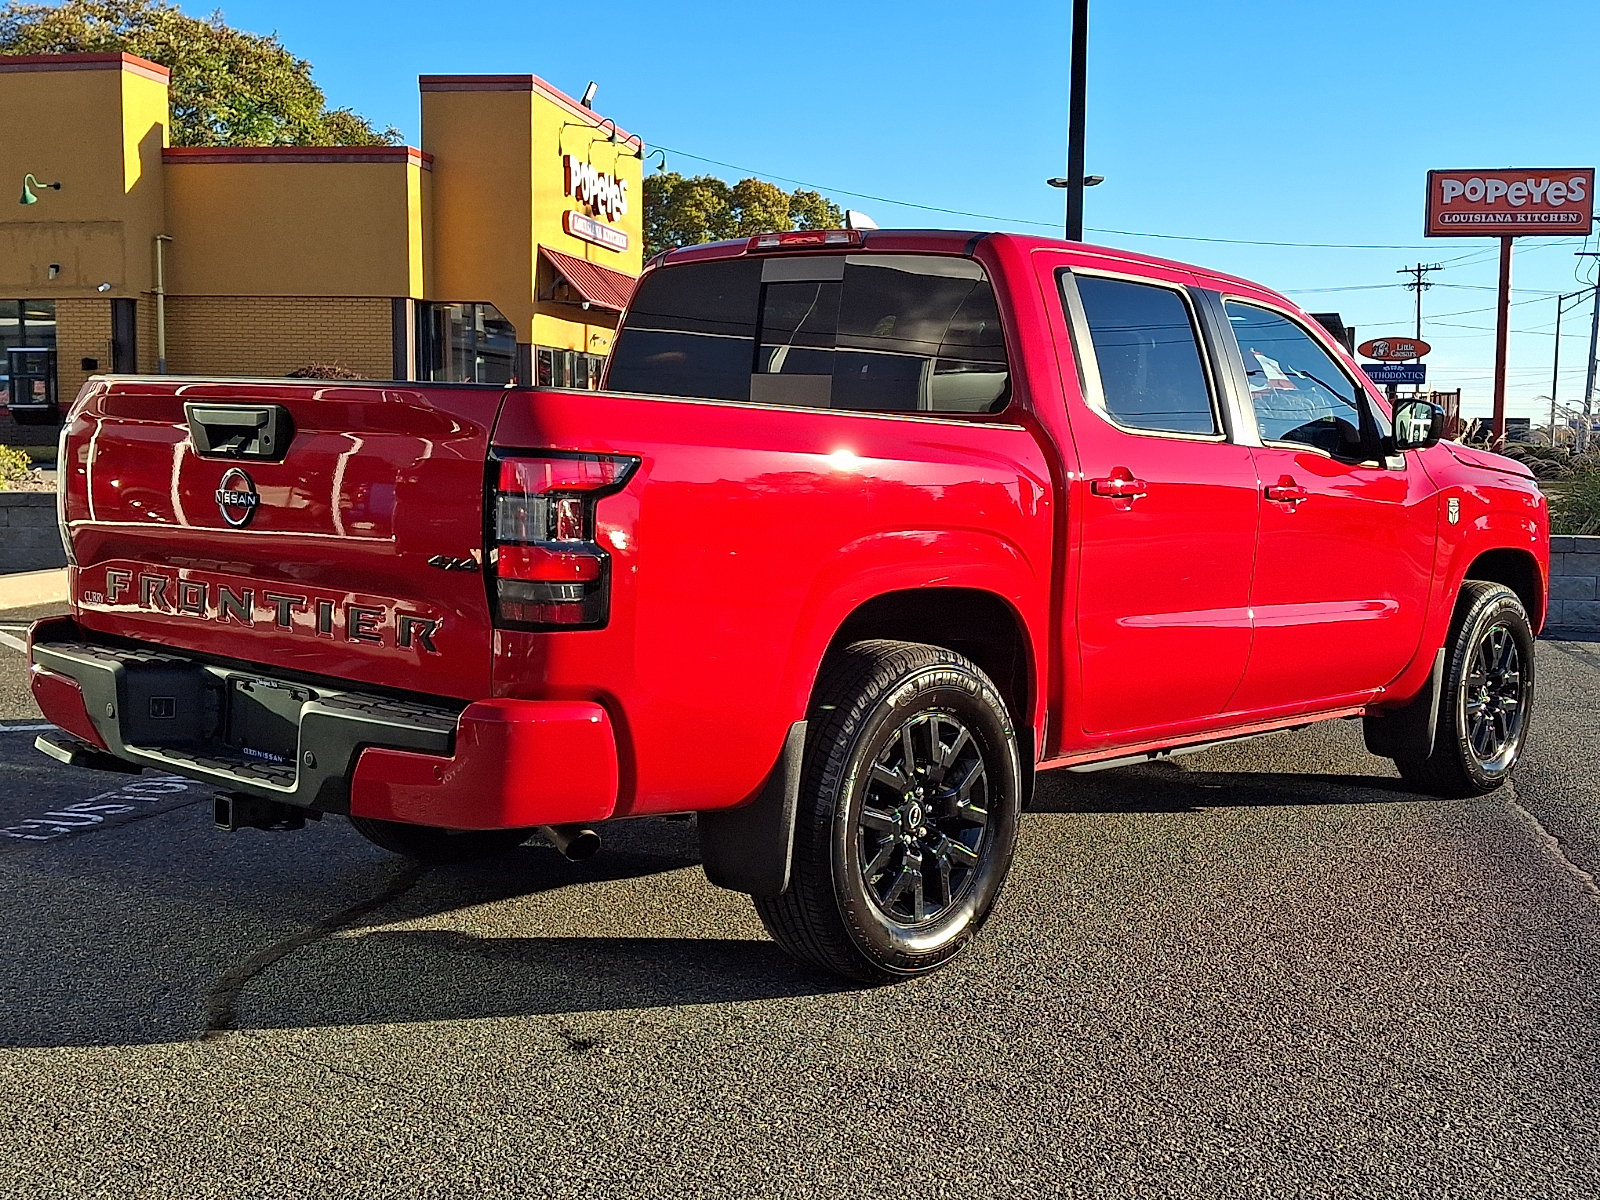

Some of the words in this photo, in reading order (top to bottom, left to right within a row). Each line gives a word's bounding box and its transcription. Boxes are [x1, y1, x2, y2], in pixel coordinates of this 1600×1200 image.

[1444, 213, 1513, 223] LOUISIANA
[1516, 213, 1578, 222] KITCHEN
[214, 490, 256, 505] NISSAN
[84, 591, 104, 603] CURRY
[106, 567, 441, 654] FRONTIER
[917, 671, 977, 693] MICHELIN
